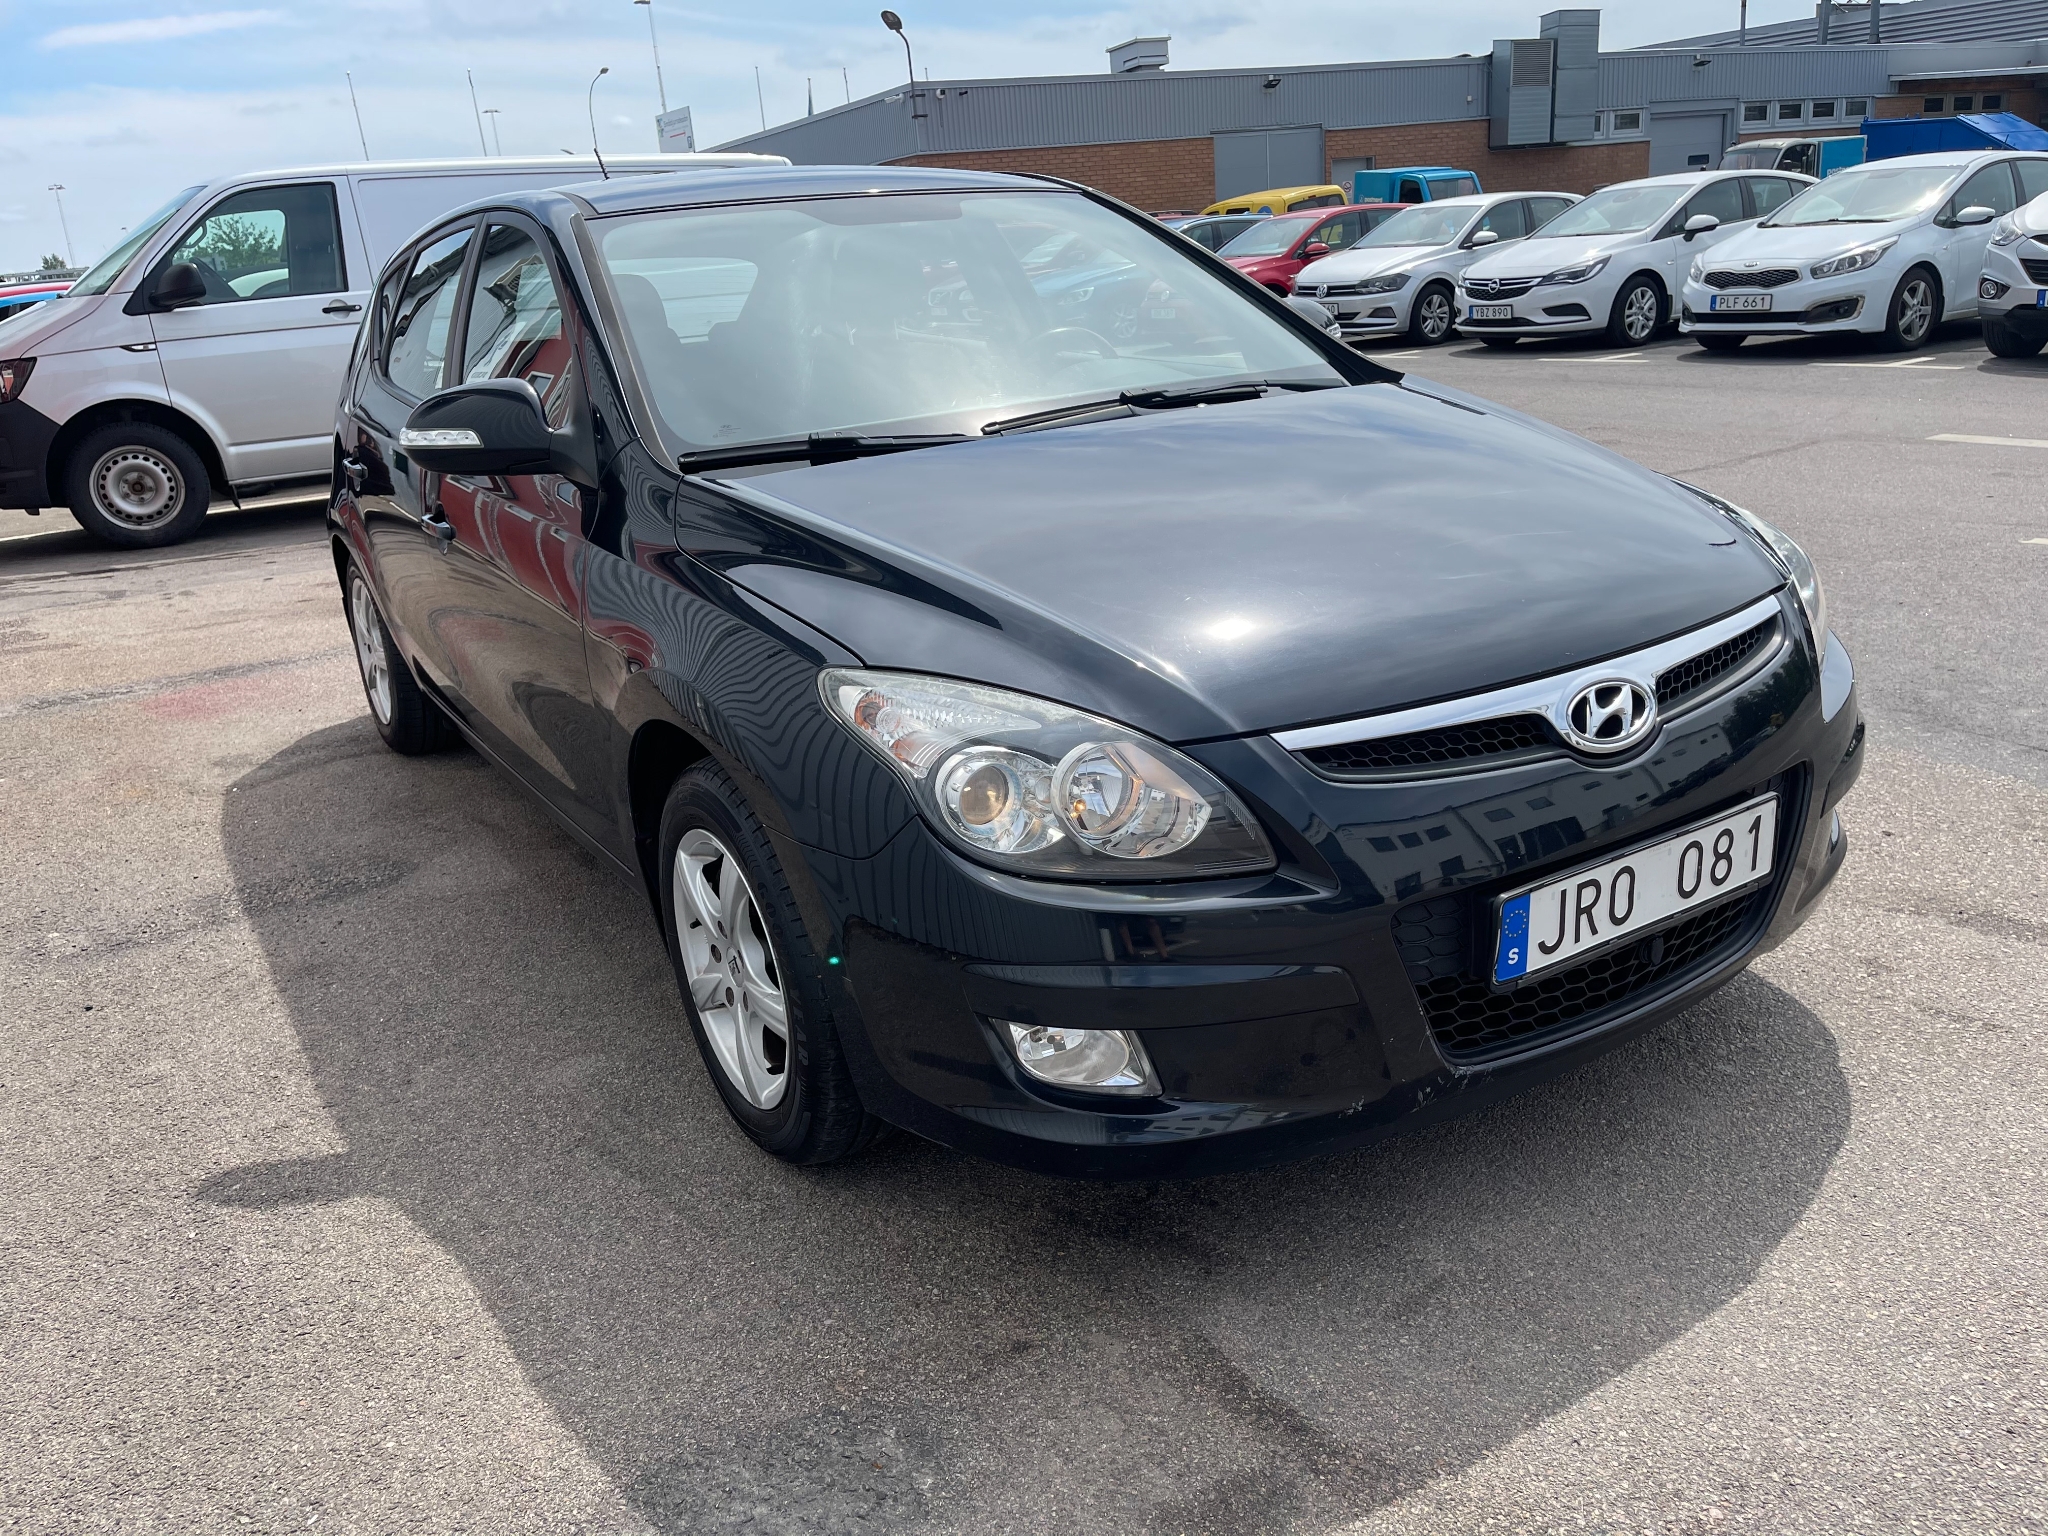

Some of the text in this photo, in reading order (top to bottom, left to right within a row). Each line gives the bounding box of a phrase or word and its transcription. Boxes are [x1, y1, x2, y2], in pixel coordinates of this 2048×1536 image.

[1718, 297, 1740, 309] PLF
[1742, 296, 1765, 308] 661
[1475, 307, 1490, 318] YBZ
[1491, 307, 1508, 318] 890
[1537, 814, 1763, 955] JRO 081
[1507, 947, 1519, 966] S
